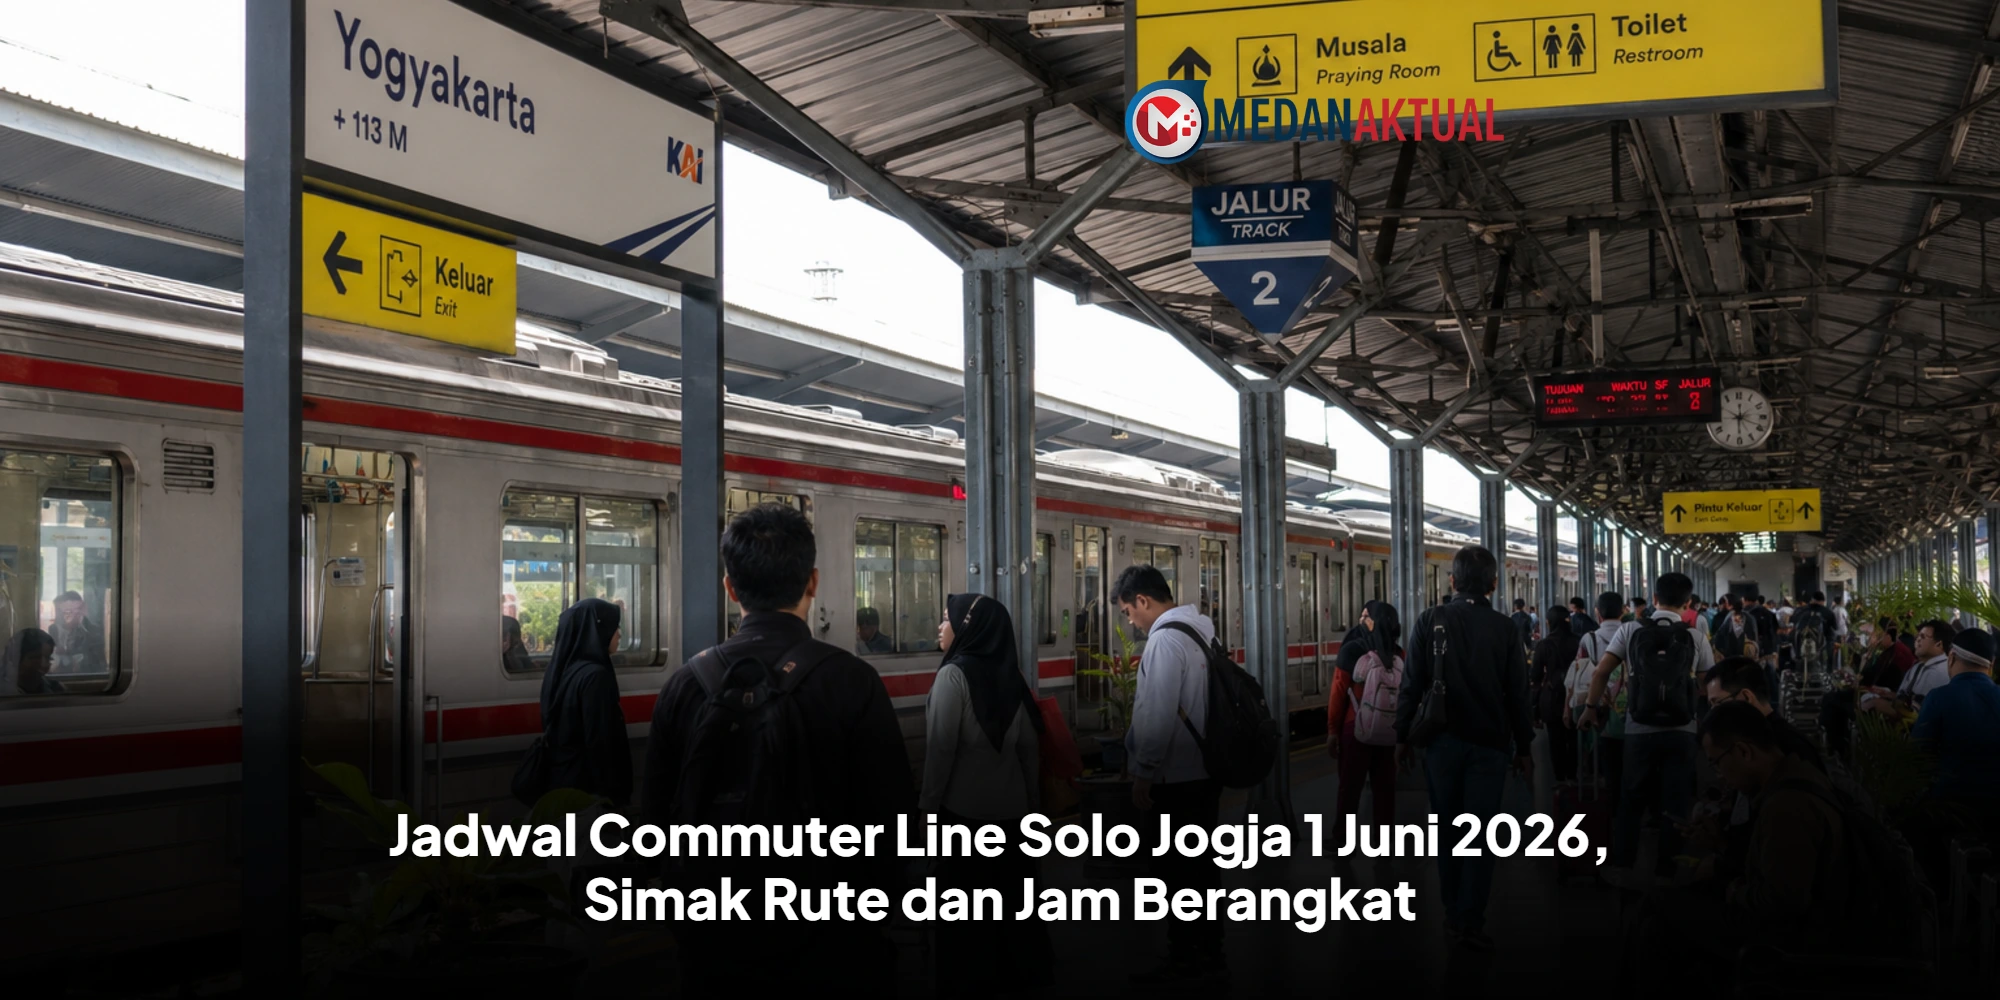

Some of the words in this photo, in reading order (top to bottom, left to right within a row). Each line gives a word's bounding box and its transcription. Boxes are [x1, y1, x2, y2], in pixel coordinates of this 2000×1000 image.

[1611, 13, 1687, 37] Toilet
[1316, 33, 1407, 58] Musala
[1613, 44, 1704, 65] Restroom
[333, 10, 535, 135] Yogyakarta
[1315, 65, 1385, 88] Praying
[1389, 62, 1441, 81] Room
[353, 111, 382, 144] 113
[389, 121, 407, 153] M
[667, 136, 704, 184] KAI
[1210, 187, 1311, 216] JALUR
[1231, 221, 1292, 239] TRACK
[435, 256, 494, 298] Keluar
[1251, 270, 1280, 306] 2
[435, 296, 457, 318] Exit
[1611, 381, 1648, 392] WAKTU
[1655, 380, 1669, 390] SF
[1678, 378, 1712, 389] JALUR
[1694, 502, 1724, 513] Pintu
